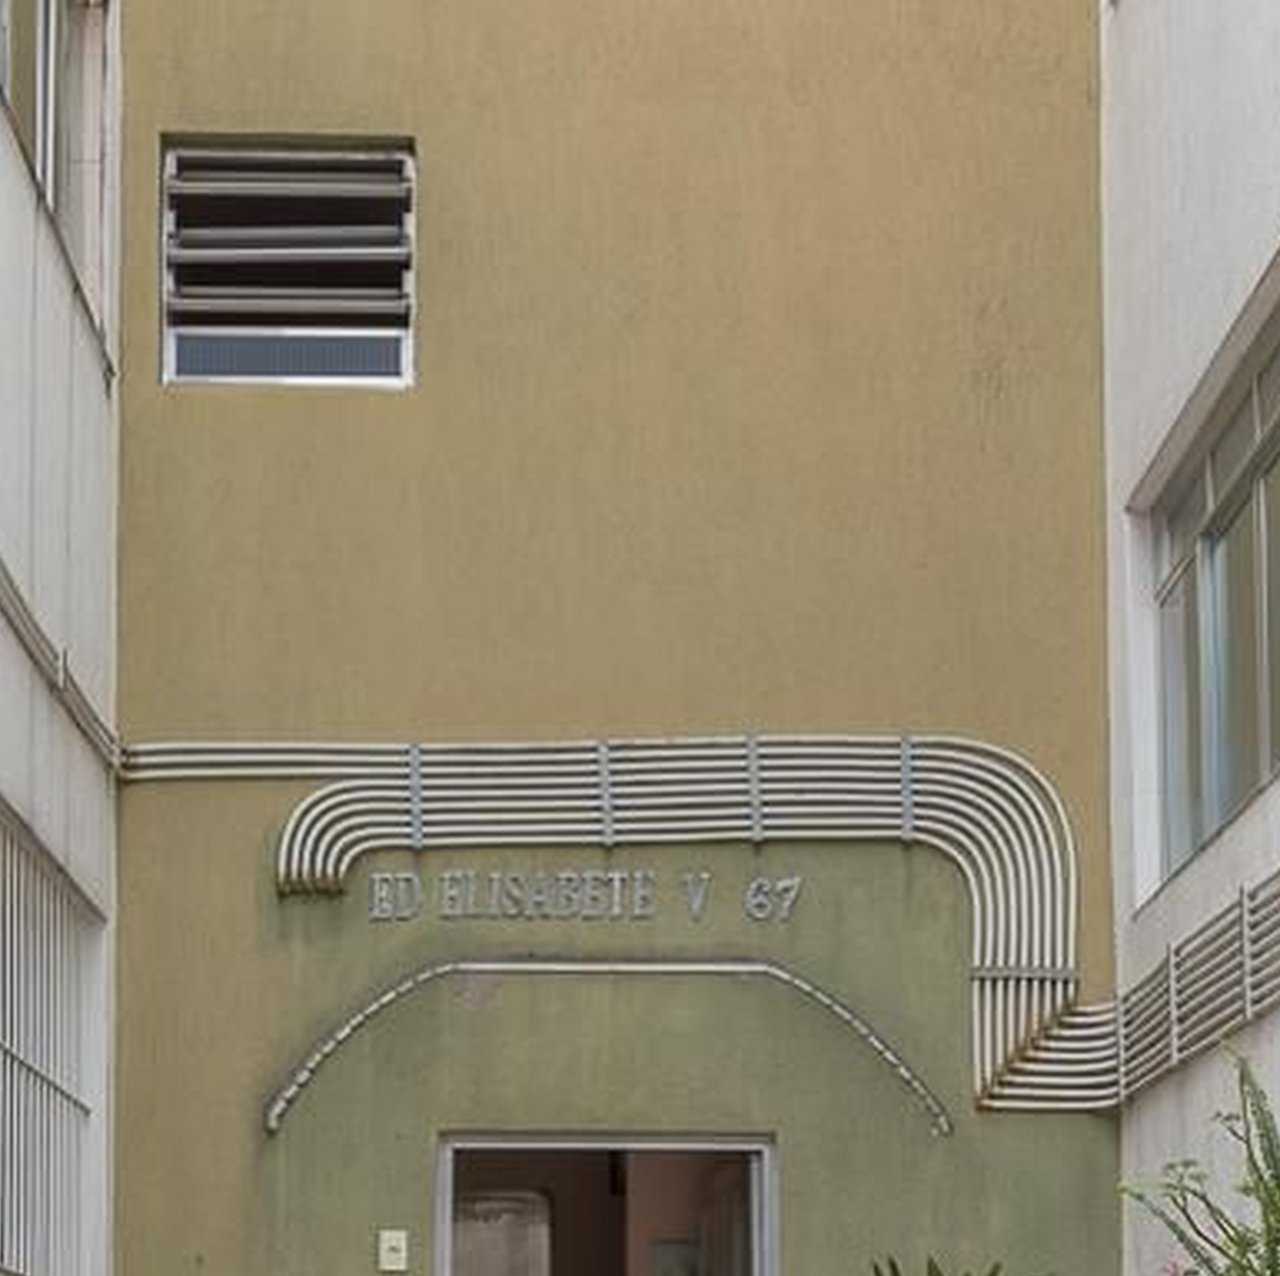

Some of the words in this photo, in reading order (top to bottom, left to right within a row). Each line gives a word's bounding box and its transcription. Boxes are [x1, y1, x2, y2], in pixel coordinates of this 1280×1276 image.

[370, 872, 419, 922] ED
[438, 871, 657, 921] ELISABETE
[682, 870, 713, 923] V
[744, 876, 801, 922] 67
